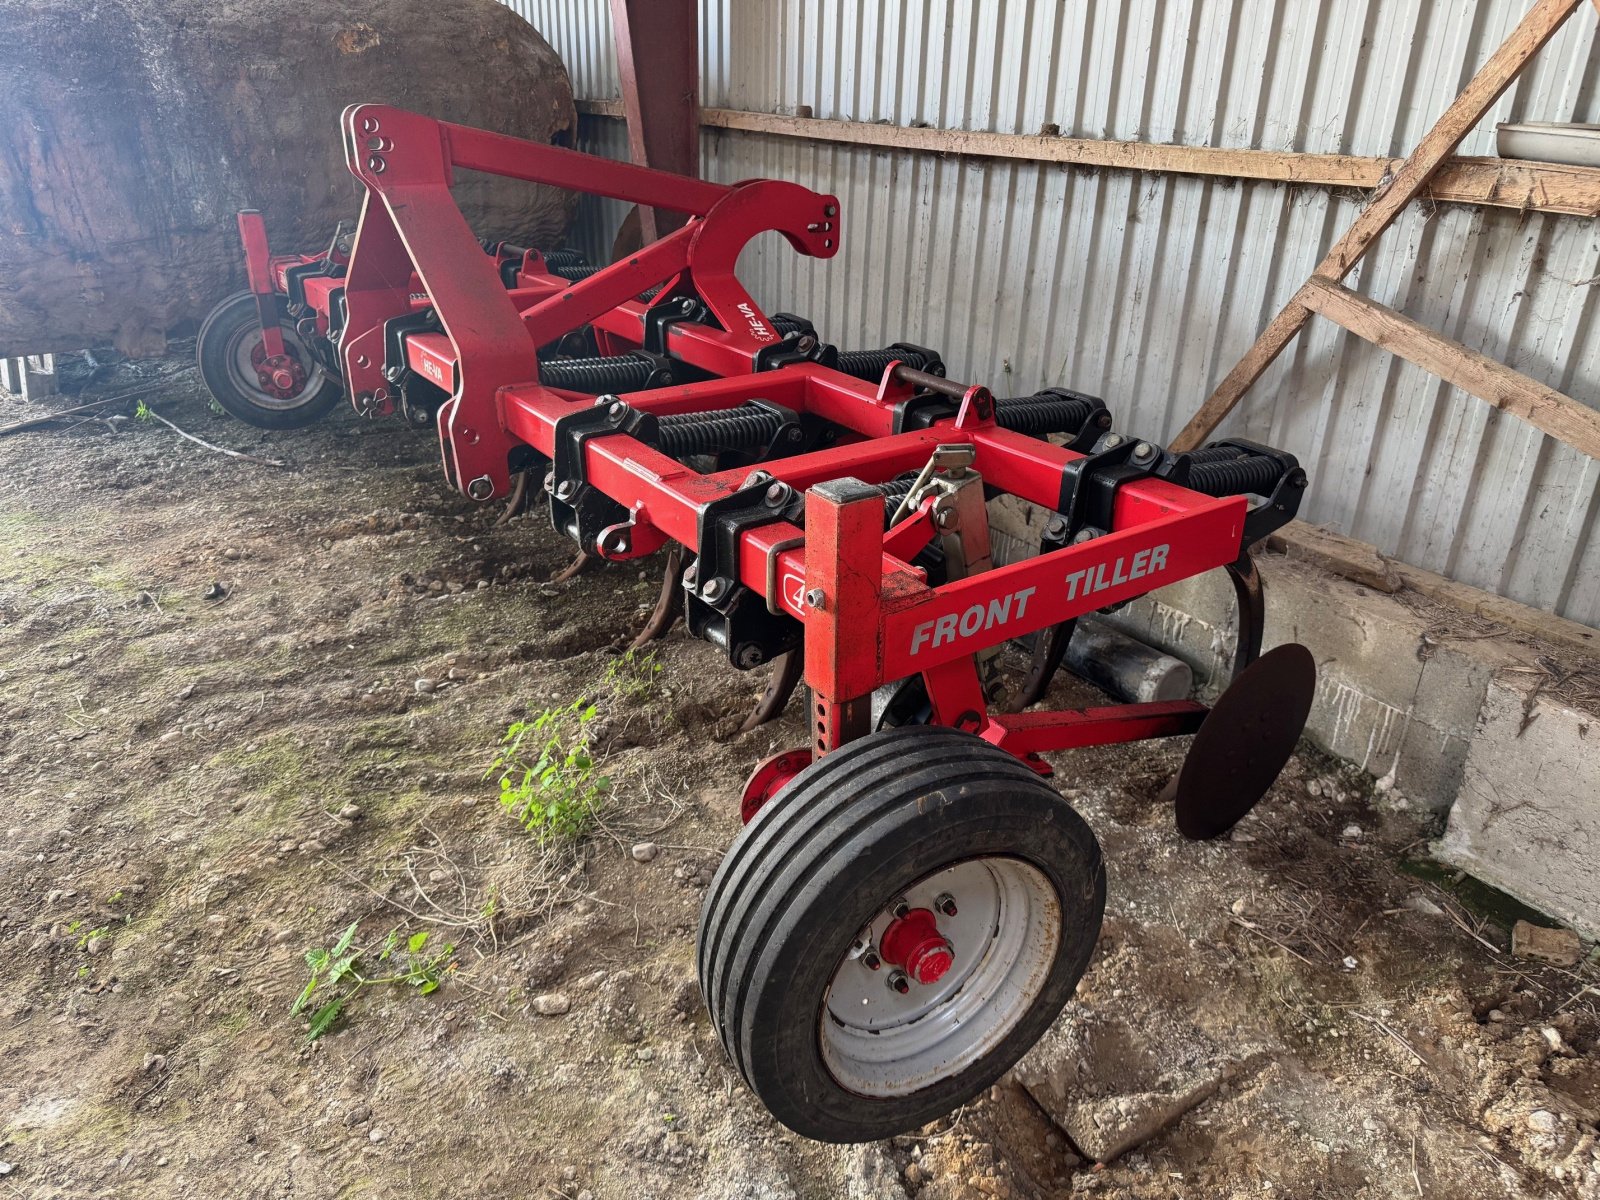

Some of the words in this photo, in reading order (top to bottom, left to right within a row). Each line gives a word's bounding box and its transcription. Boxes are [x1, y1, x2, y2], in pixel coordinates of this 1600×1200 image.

[737, 303, 769, 335] HE-VA
[909, 587, 1037, 656] FRONT
[1065, 544, 1170, 602] TILLER
